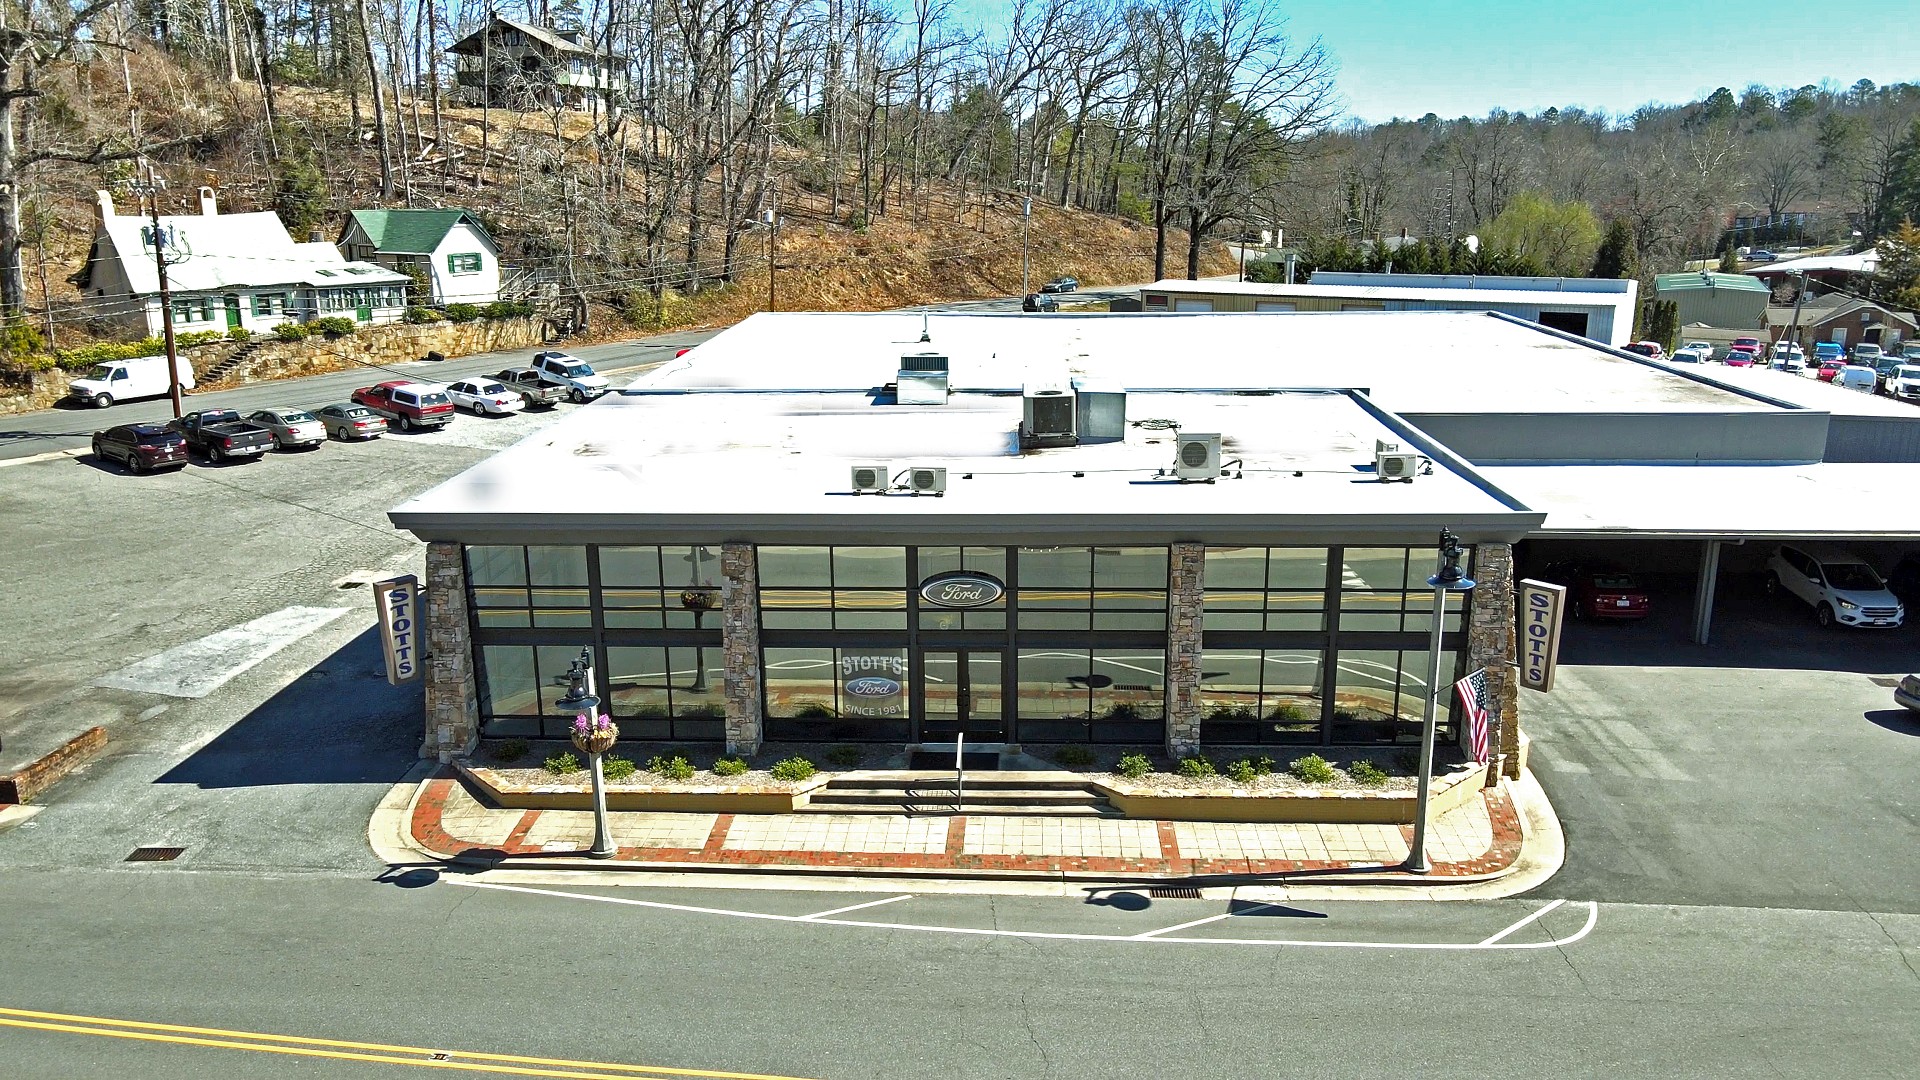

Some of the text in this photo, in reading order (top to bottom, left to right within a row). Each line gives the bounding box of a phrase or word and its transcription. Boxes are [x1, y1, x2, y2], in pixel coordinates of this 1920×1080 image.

[941, 584, 982, 600] Ford
[389, 588, 412, 674] STOTTS
[1529, 593, 1549, 681] STOTTS
[842, 655, 902, 675] STOTT'S
[855, 680, 890, 694] Ford
[845, 704, 902, 716] SINCE 1981
